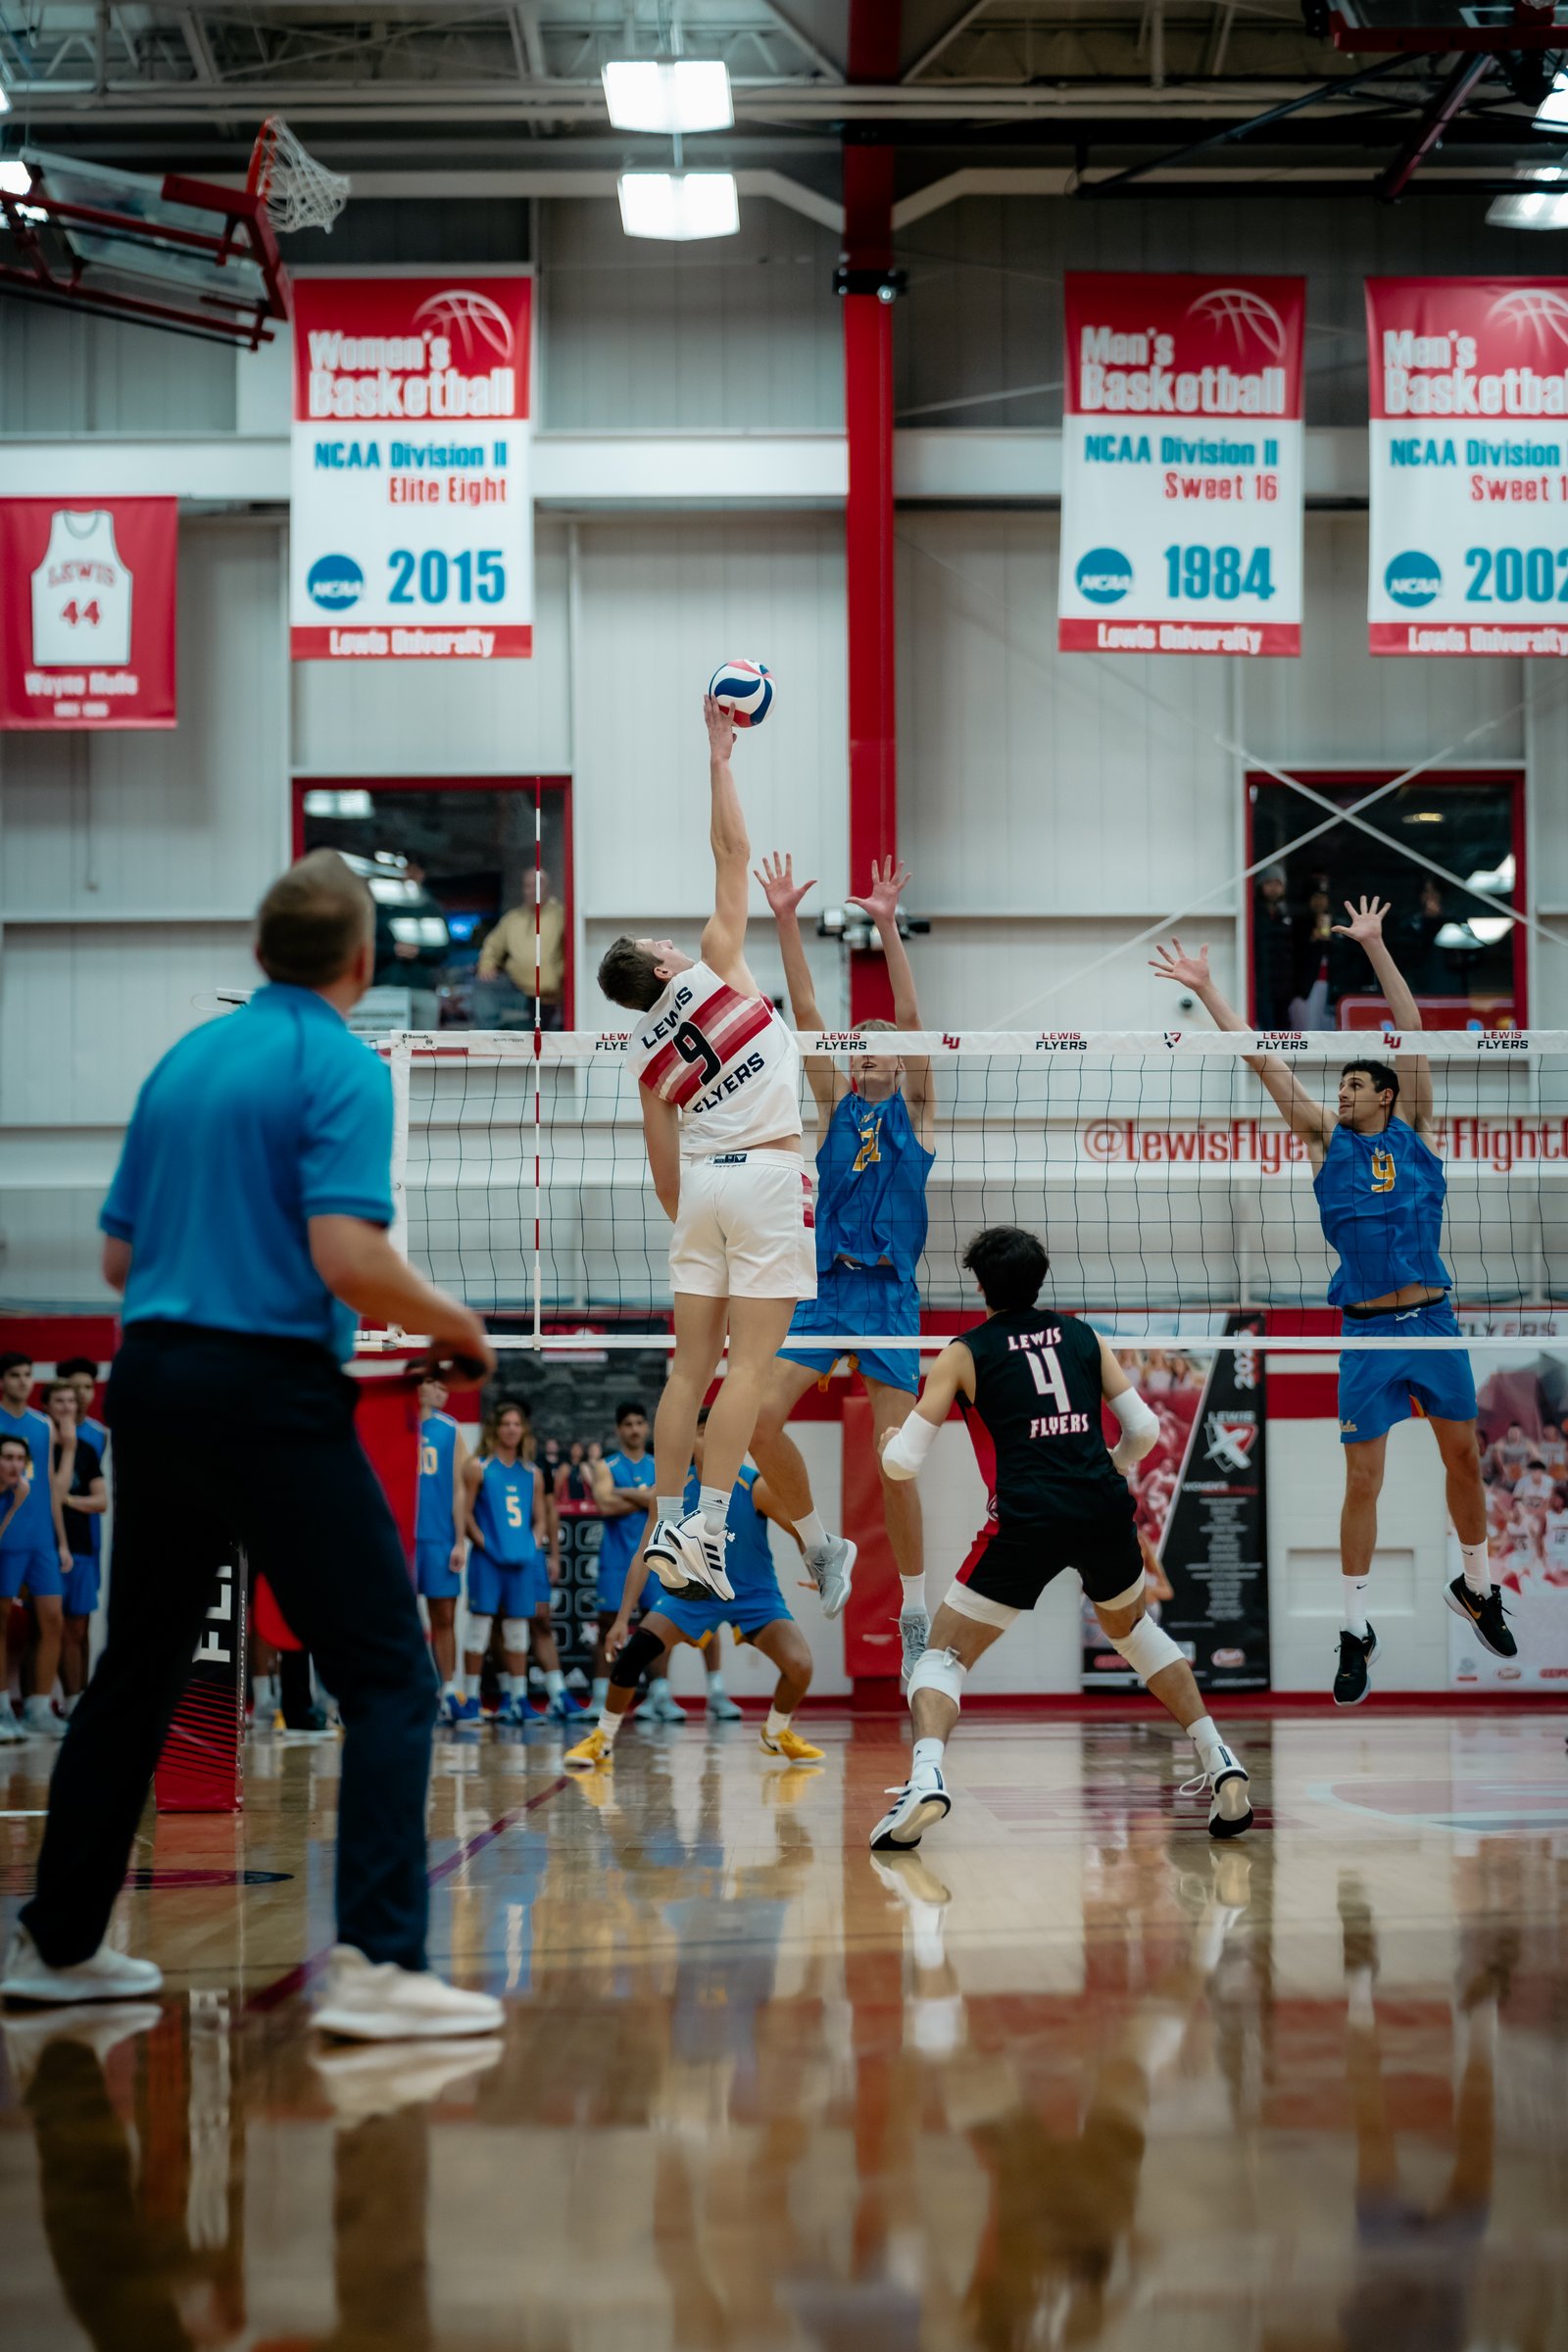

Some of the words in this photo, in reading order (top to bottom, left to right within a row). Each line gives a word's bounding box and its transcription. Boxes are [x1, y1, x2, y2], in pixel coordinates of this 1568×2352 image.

[308, 330, 450, 370] Women's
[1081, 326, 1174, 366] Men's
[1383, 330, 1477, 368] Men's
[309, 368, 514, 416] Basketball
[1080, 364, 1285, 414] Basketball
[316, 442, 380, 468] NCAA
[391, 442, 484, 467] Division
[494, 442, 507, 466] II
[1084, 434, 1152, 464] NCAA
[1160, 436, 1254, 466] Division
[1263, 439, 1278, 466] II
[1390, 439, 1456, 466] NCAA
[1466, 439, 1560, 466] Division
[389, 476, 439, 504] Elite
[448, 476, 507, 506] Eight
[1165, 472, 1243, 500] Sweet
[1255, 474, 1277, 502] 16
[1471, 474, 1549, 502] Sweet
[47, 562, 116, 589] LEWIS
[387, 549, 506, 604] 2015
[1080, 574, 1131, 592] NCAA
[1164, 545, 1276, 600] 1984
[1391, 577, 1441, 594] NCAA
[62, 599, 100, 627] 44
[329, 628, 388, 656] Lewis
[391, 628, 495, 658] University
[1098, 622, 1155, 649] Lewis
[1159, 624, 1262, 655] University
[1408, 626, 1466, 652] Lewis
[641, 986, 694, 1051] LEWIS
[595, 1042, 630, 1051] FLYE
[672, 1021, 722, 1086] 9
[815, 1041, 867, 1051] FLYERS
[942, 1033, 960, 1049] LU
[1036, 1041, 1088, 1051] FLYERS
[1256, 1041, 1308, 1050] FLYERS
[1383, 1033, 1401, 1049] LU
[1477, 1040, 1529, 1050] FLYERS
[852, 1117, 882, 1172] 21
[1371, 1152, 1396, 1193] 9
[1007, 1327, 1062, 1350] LEWIS
[1025, 1347, 1072, 1413] 4
[1029, 1413, 1089, 1440] FLYERS
[1207, 1411, 1255, 1422] LEWIS
[506, 1495, 522, 1527] 5
